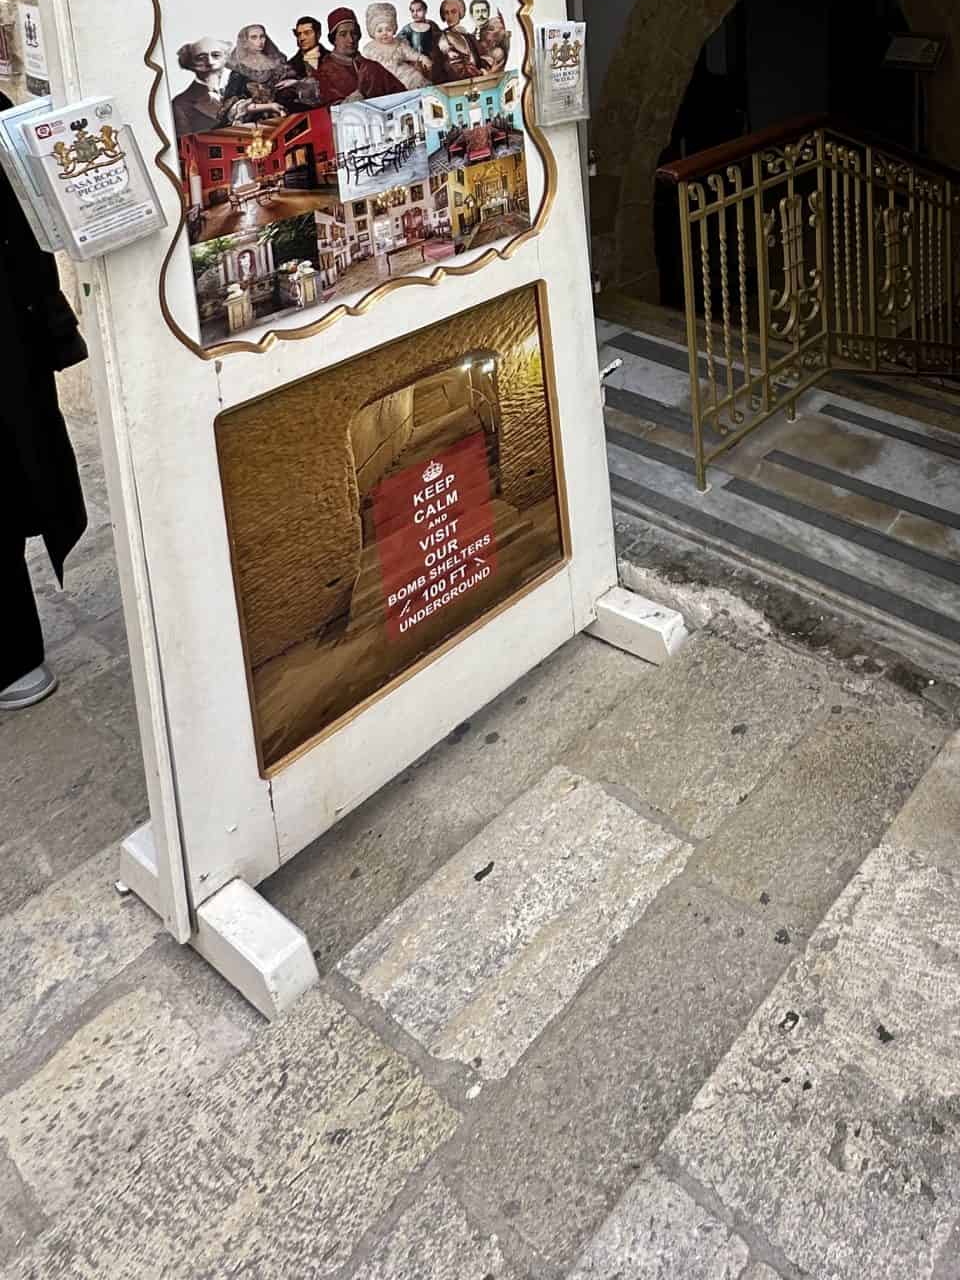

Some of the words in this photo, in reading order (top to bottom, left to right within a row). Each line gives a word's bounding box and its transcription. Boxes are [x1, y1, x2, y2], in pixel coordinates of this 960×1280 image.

[412, 473, 456, 508] KEEP
[414, 489, 459, 525] CALM
[418, 519, 459, 552] VISIT
[428, 513, 449, 531] AND
[387, 575, 427, 608] BOMB
[429, 533, 492, 581] SHELTERS
[424, 538, 459, 568] OUR
[399, 565, 491, 634] UNDERGROUND
[422, 578, 446, 603] 100
[450, 564, 468, 586] FT
